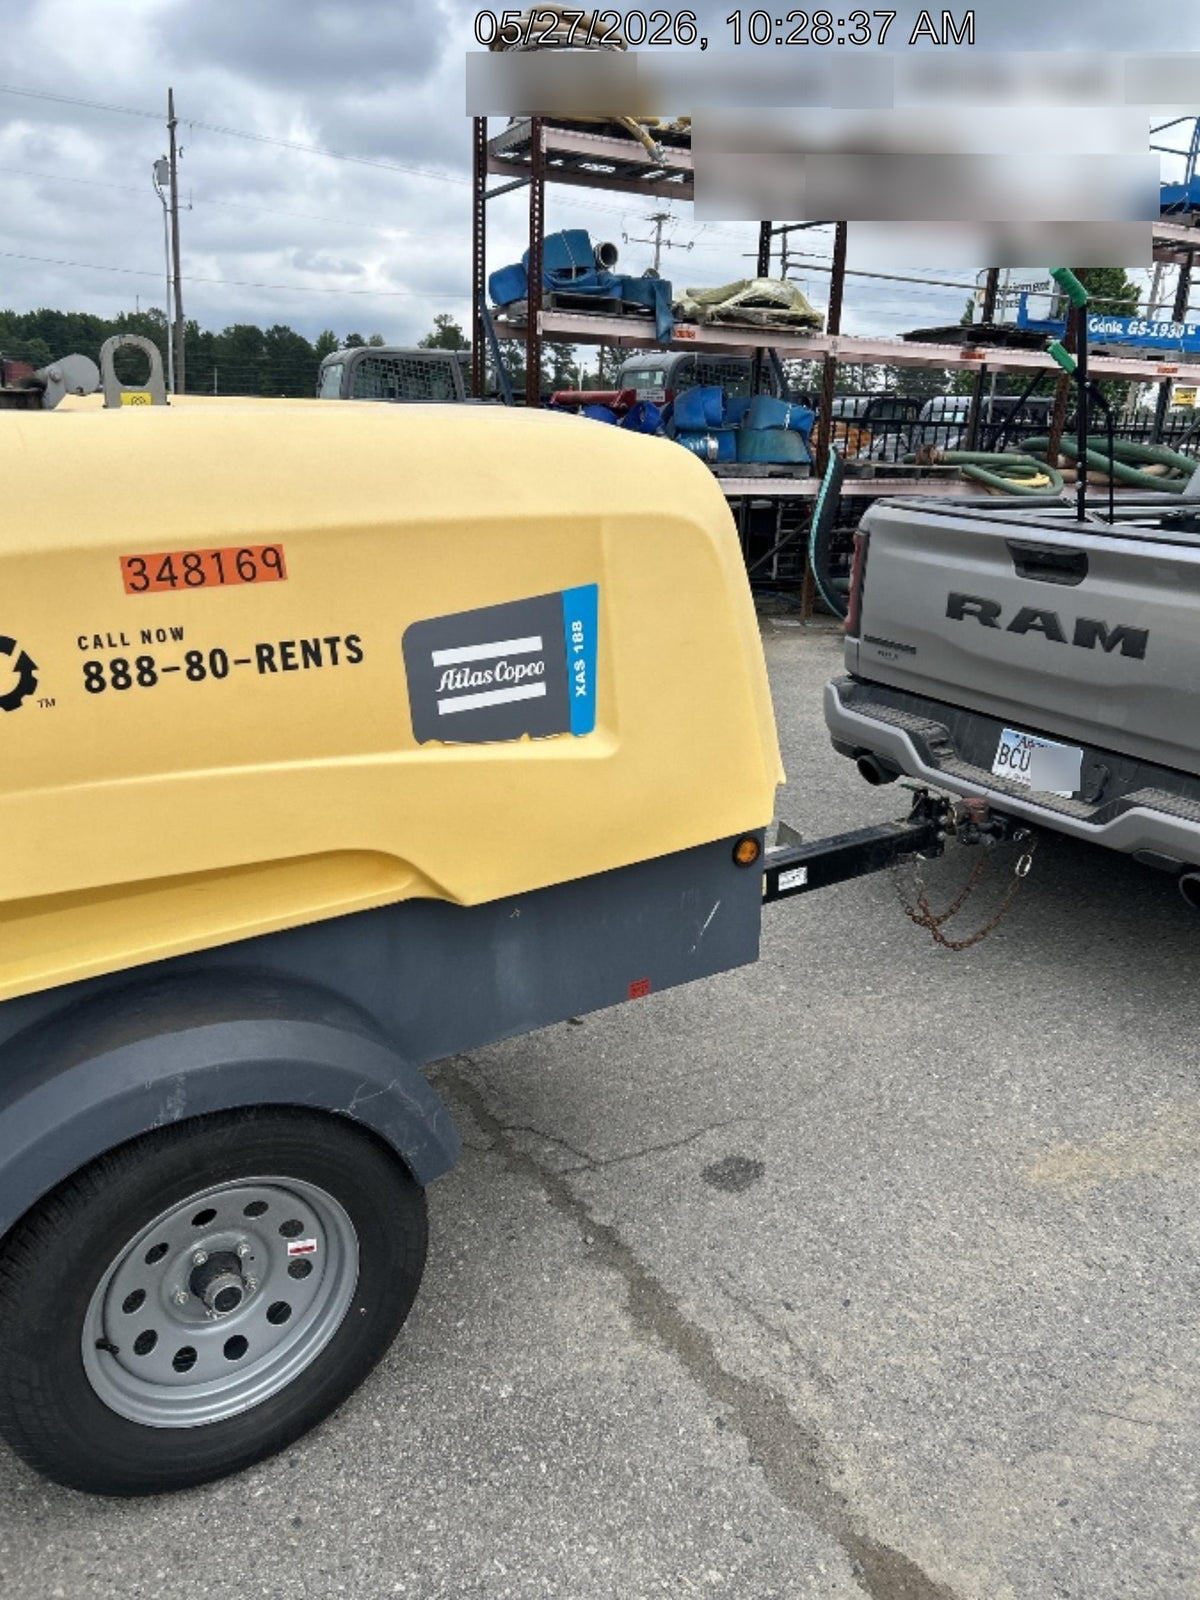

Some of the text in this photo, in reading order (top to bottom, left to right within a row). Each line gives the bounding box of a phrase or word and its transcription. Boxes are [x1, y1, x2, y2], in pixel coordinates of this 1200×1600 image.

[1089, 317, 1124, 335] Genie
[126, 547, 285, 592] 348169
[77, 626, 185, 650] CALL NOW
[945, 591, 1149, 660] RAM
[82, 634, 364, 694] 888-80-RENTS
[435, 661, 545, 692] Atlas Copco
[571, 620, 587, 697] XAS 188
